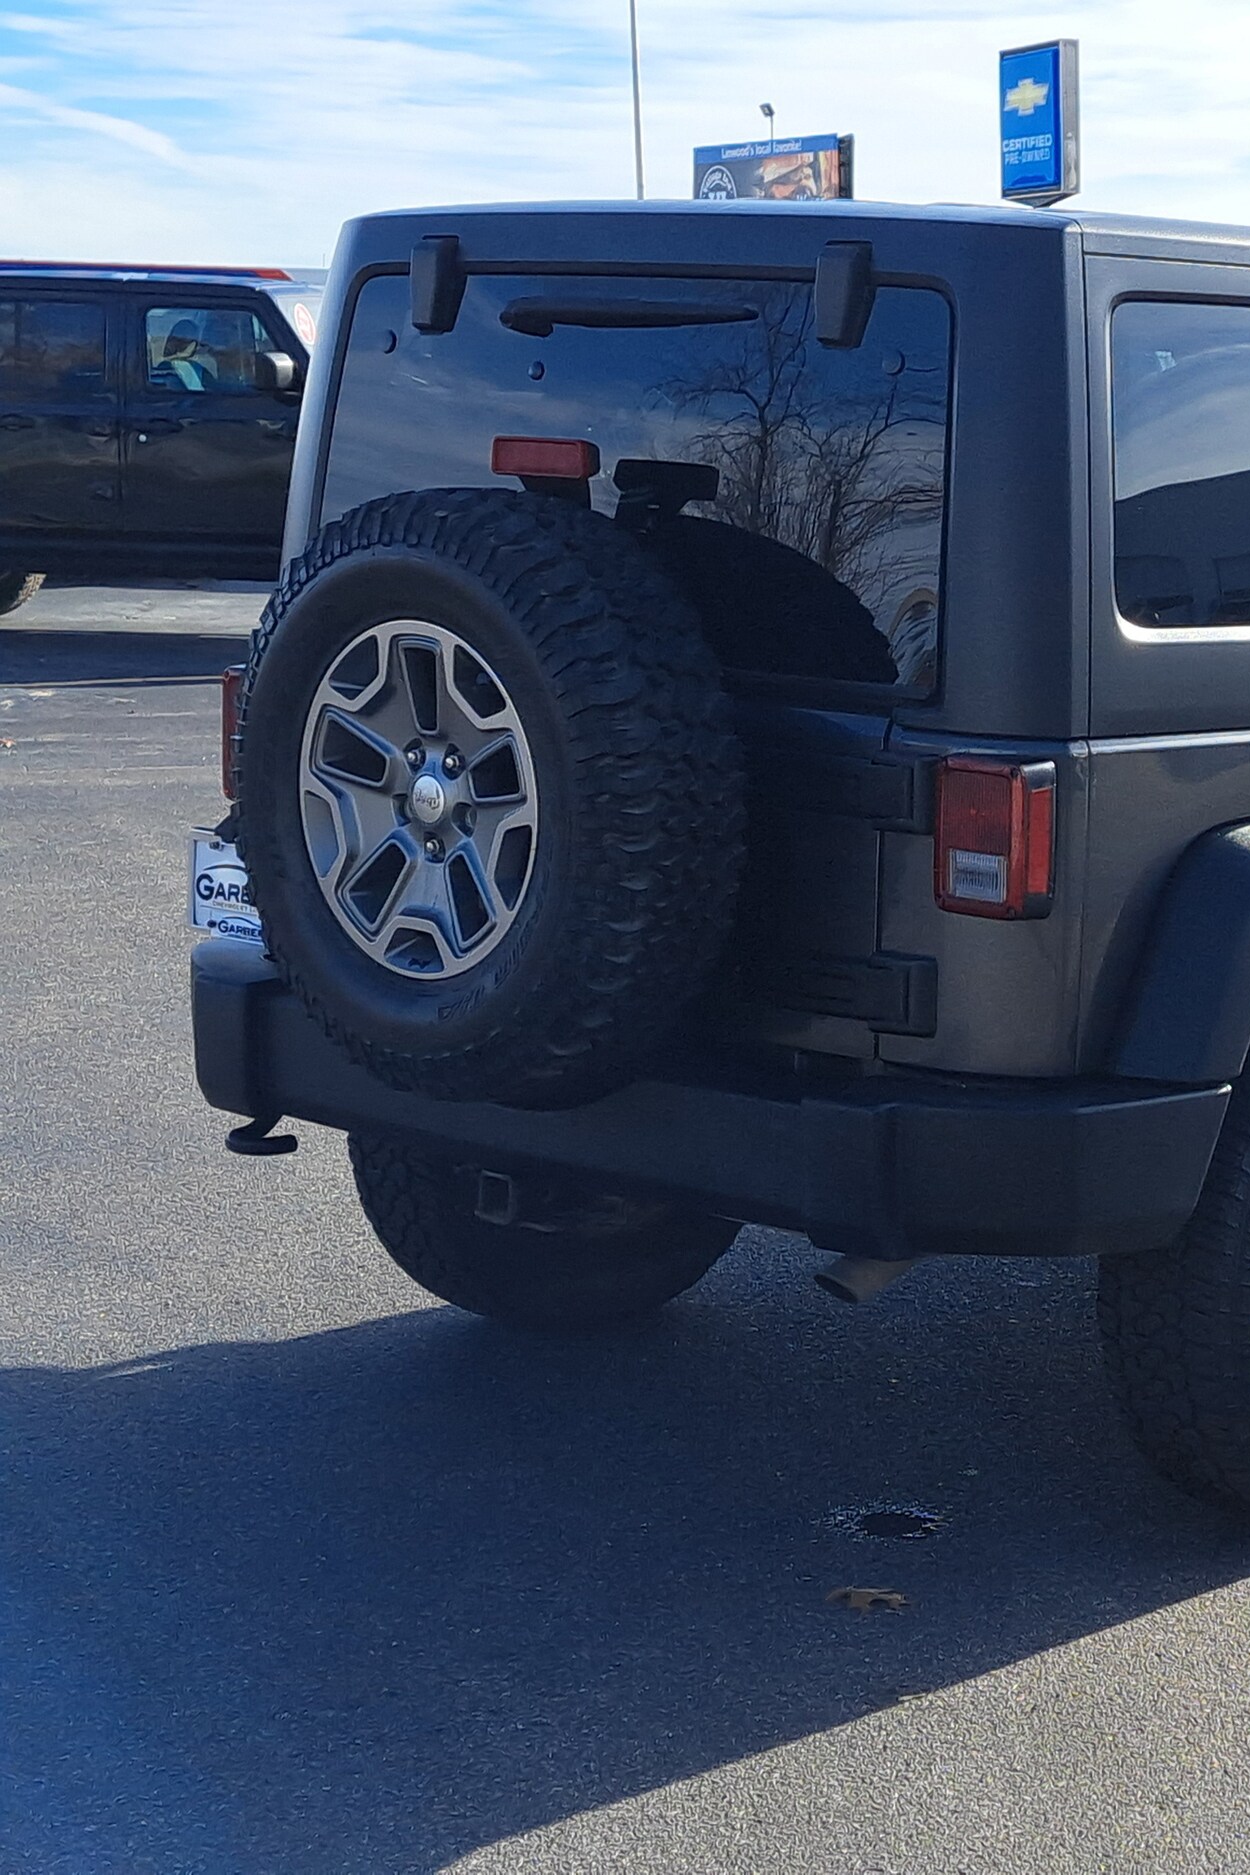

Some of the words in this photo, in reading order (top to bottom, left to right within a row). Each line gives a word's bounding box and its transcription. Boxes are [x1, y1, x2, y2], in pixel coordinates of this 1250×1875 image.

[755, 142, 771, 155] local
[1003, 134, 1053, 152] CERTIFIED
[1005, 148, 1050, 165] PRE-OWNED
[196, 873, 252, 906] GARB
